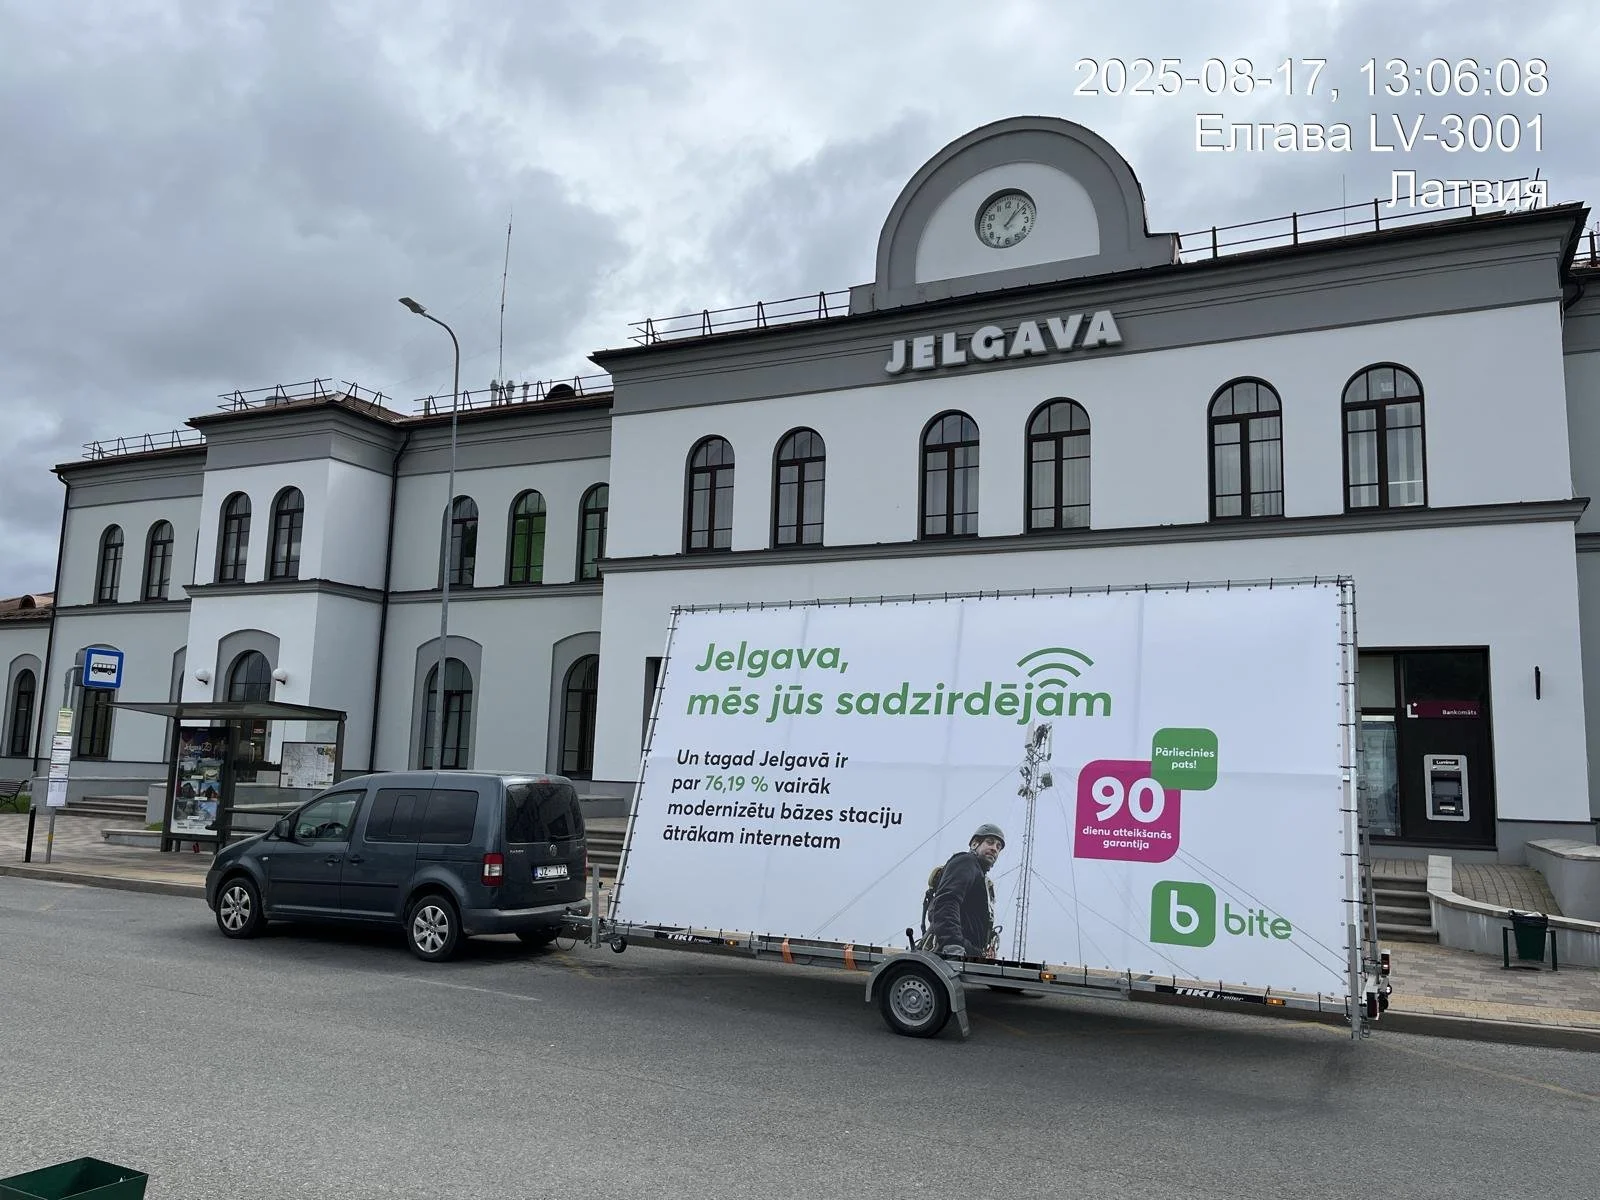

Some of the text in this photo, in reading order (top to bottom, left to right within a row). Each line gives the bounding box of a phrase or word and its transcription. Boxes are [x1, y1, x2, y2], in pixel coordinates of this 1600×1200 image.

[884, 310, 1123, 374] JELGAVA
[695, 641, 849, 678] Jelgava,
[687, 682, 1112, 725] mēs jūs sadzirdējam
[677, 749, 849, 771] Un tagad Jelgavā ir
[1155, 746, 1215, 759] Pārliecinies
[1171, 760, 1198, 771] pats!
[671, 775, 831, 795] par 76,19 % vairāk
[1091, 776, 1165, 824] 90
[667, 799, 903, 828] modernizētu bāzes staciju
[662, 825, 841, 850] ātrākam internetam
[1082, 826, 1172, 840] dienu atteikšanās
[1103, 838, 1149, 851] garantija
[1169, 889, 1292, 940] b bite
[667, 933, 693, 943] TIKI
[1174, 987, 1215, 999] TIKI
